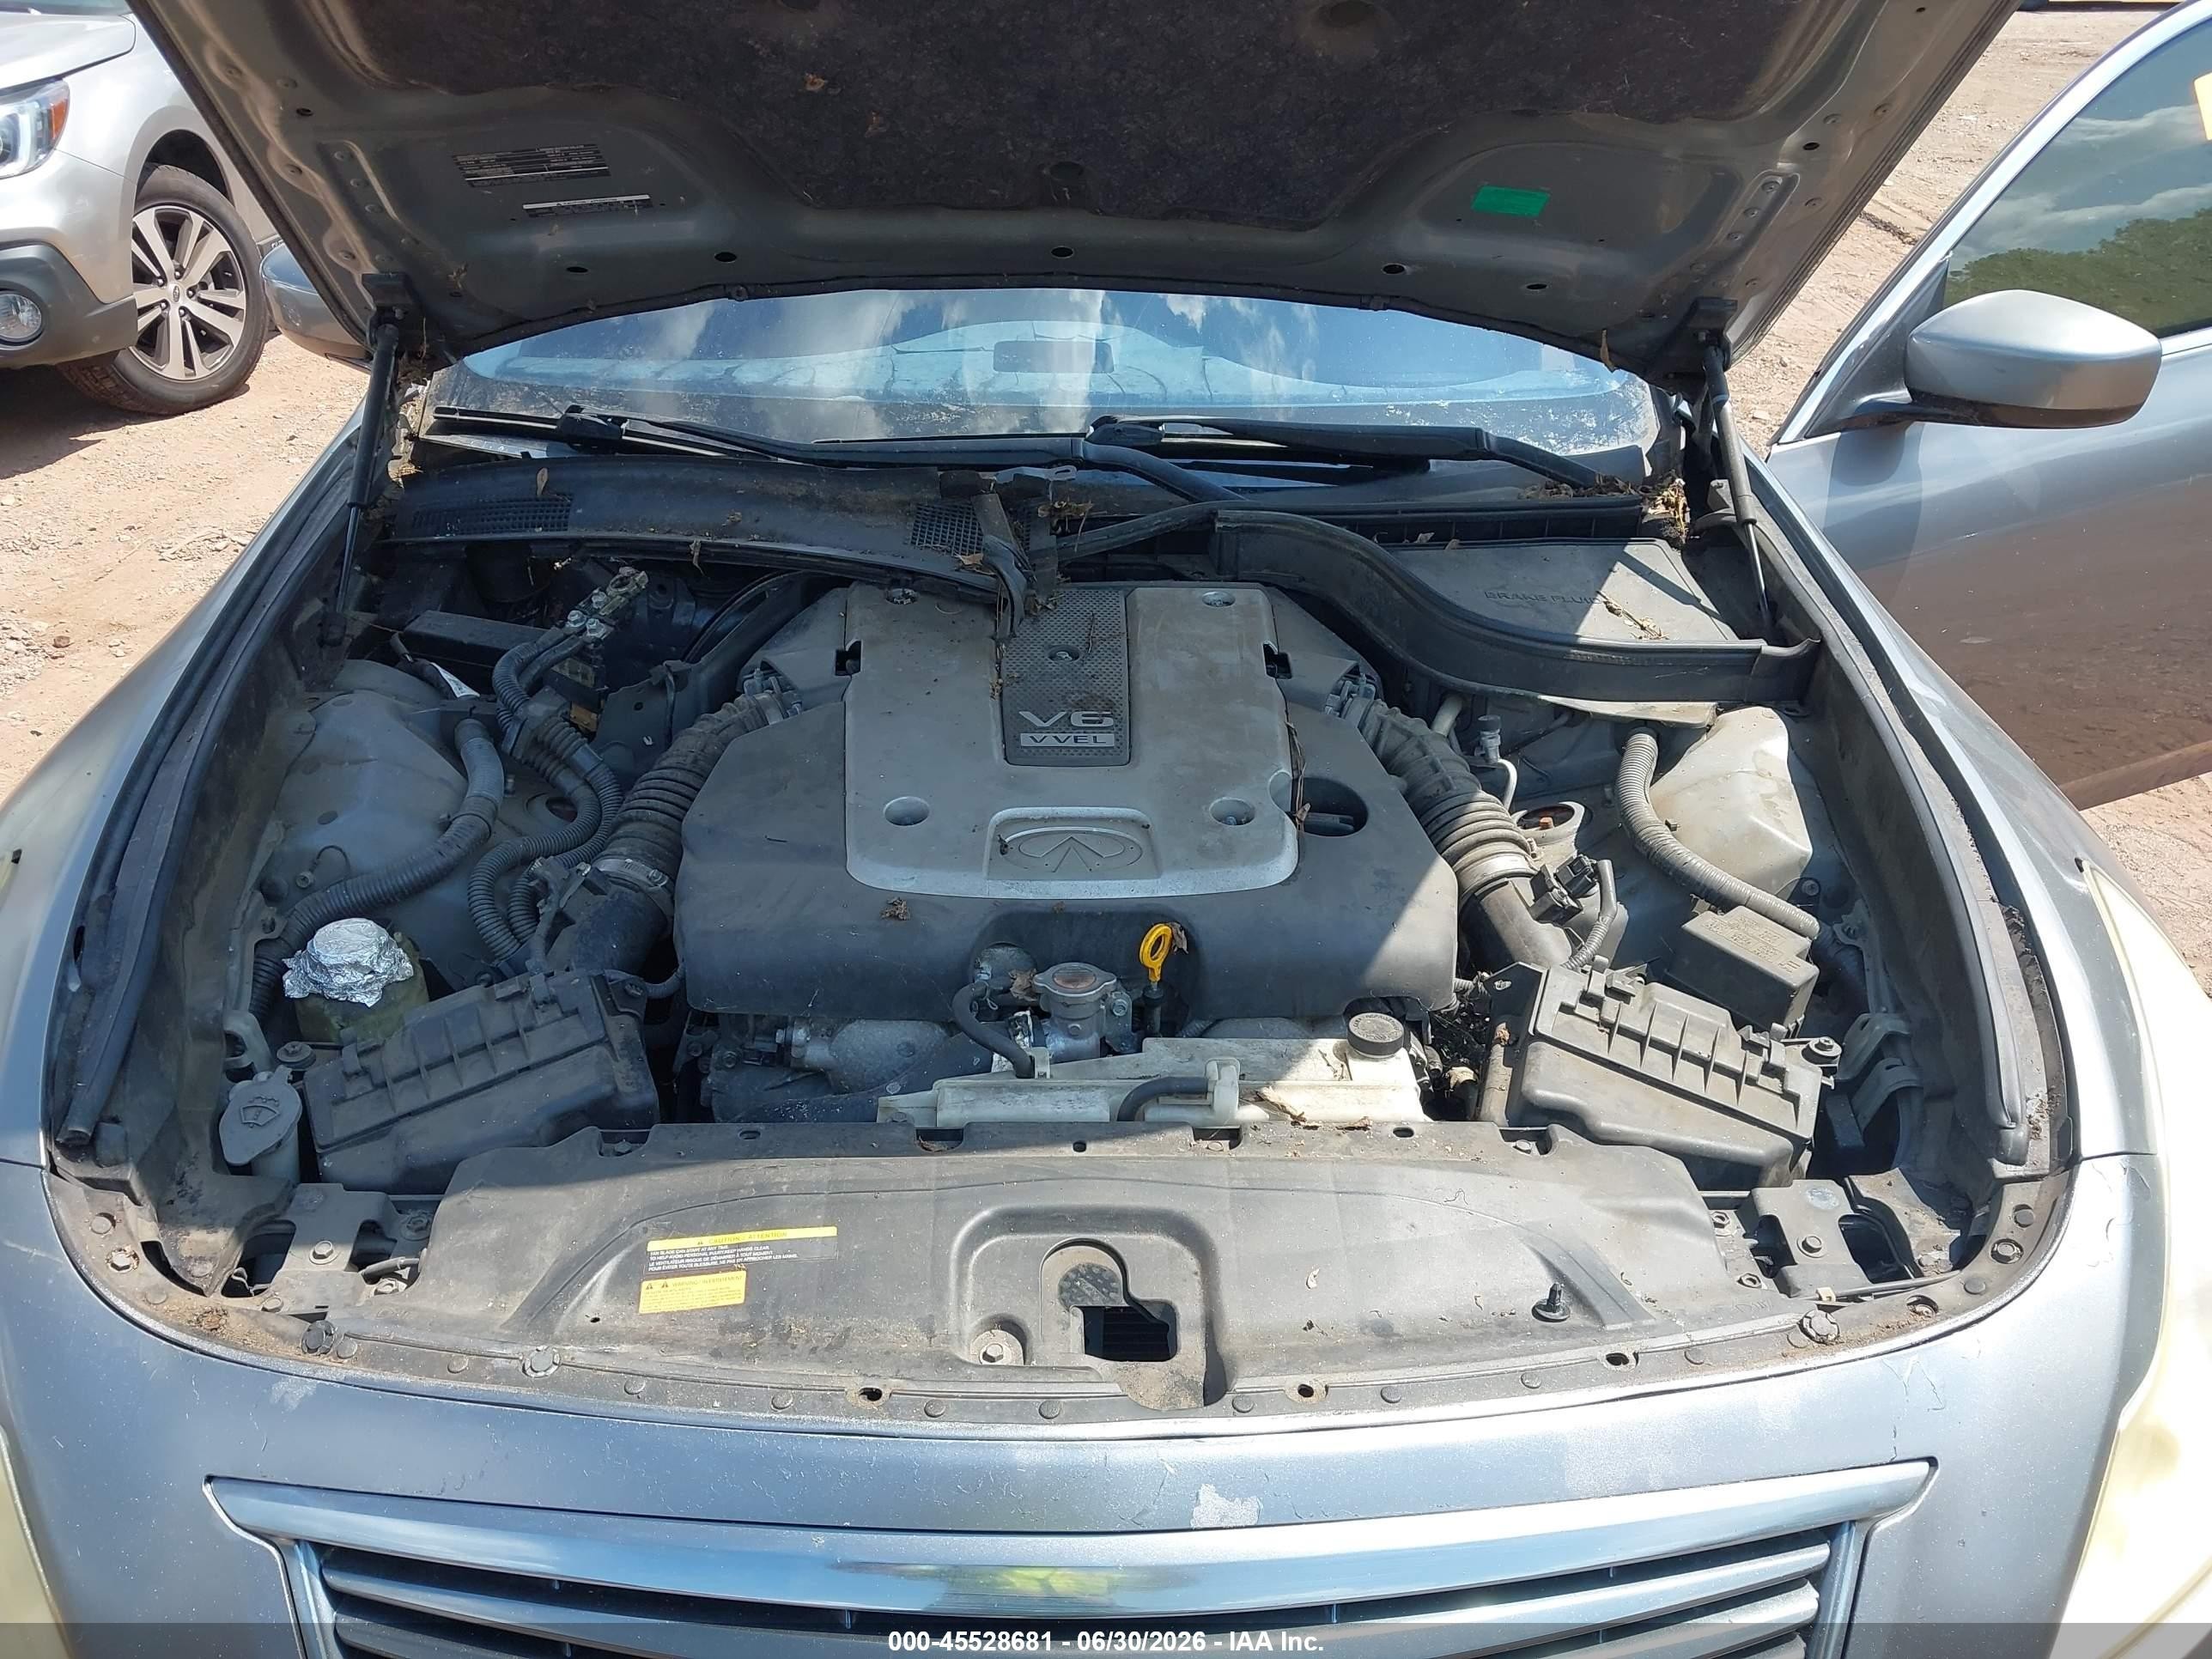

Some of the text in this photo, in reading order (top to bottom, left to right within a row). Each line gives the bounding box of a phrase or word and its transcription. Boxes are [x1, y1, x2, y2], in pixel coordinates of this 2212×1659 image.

[1485, 592, 1547, 601] BRAKE
[1018, 711, 1114, 727] V6
[1030, 735, 1107, 744] VVEL
